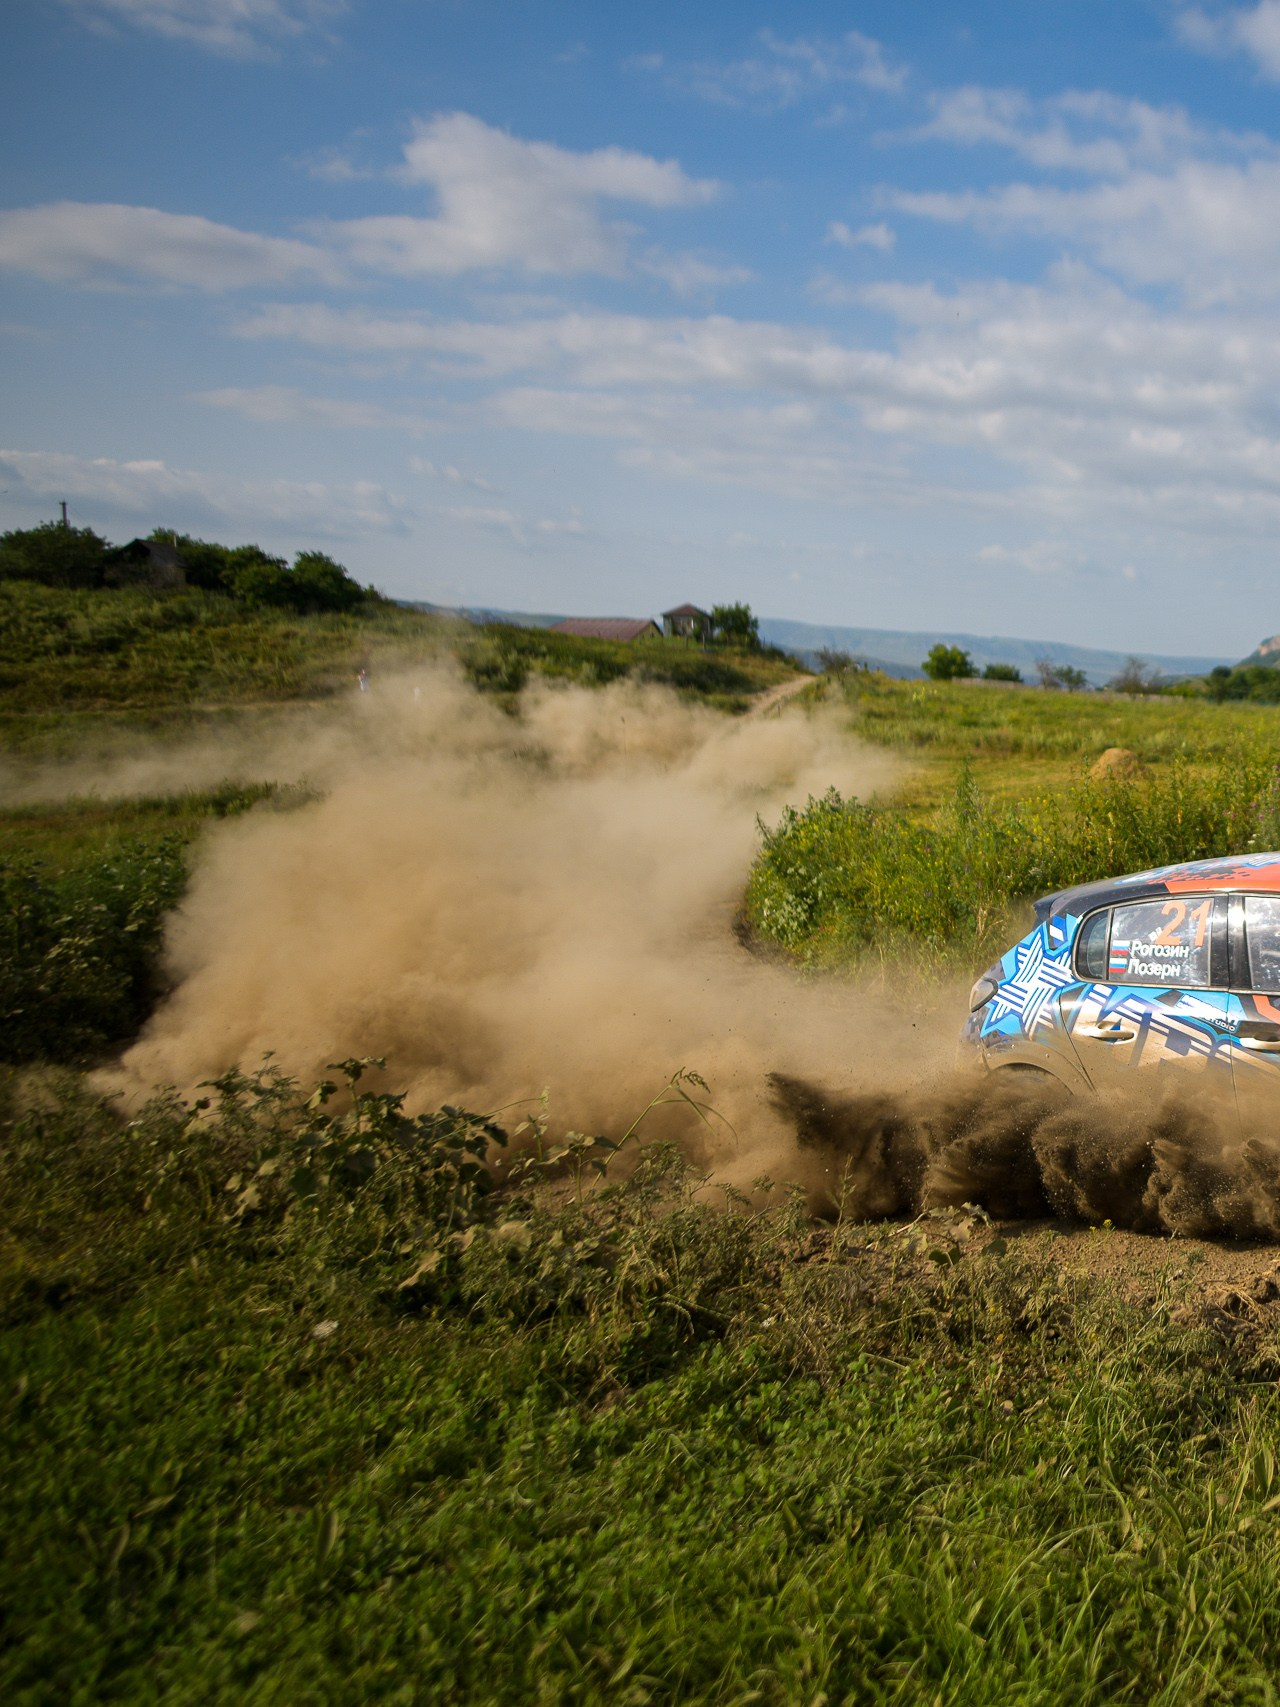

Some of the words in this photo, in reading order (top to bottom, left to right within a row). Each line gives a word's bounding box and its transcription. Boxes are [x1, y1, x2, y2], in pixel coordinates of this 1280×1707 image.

[1155, 899, 1212, 947] 21
[1131, 939, 1190, 958] Рогозин
[1127, 958, 1181, 979] Позерн
